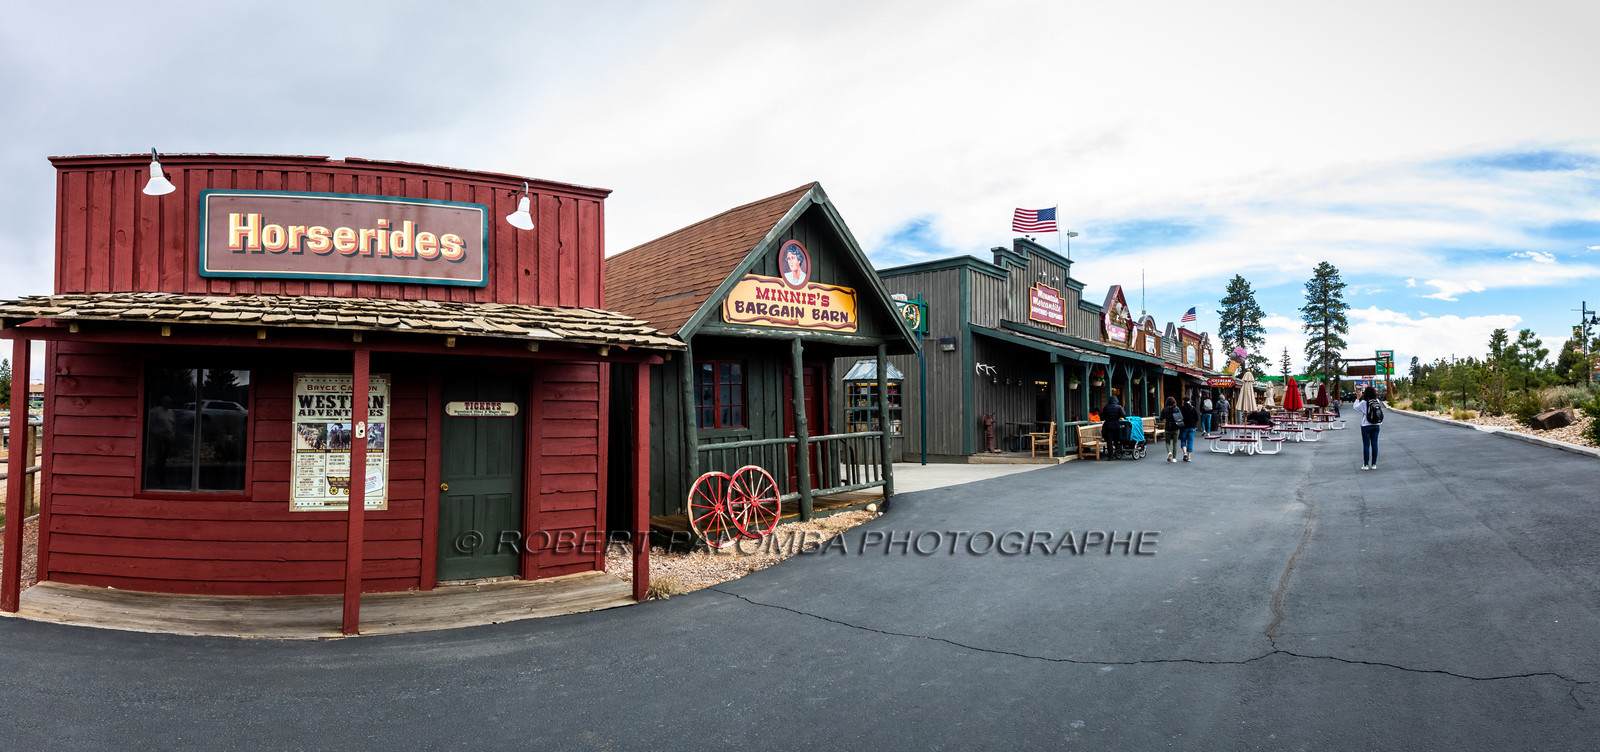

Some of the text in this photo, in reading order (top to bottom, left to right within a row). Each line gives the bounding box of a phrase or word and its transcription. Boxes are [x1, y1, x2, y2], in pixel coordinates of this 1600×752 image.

[228, 213, 466, 262] Horserides
[756, 287, 830, 307] MINNIE'S
[735, 300, 848, 323] BARGAIN BARN
[298, 395, 384, 408] WESTN
[464, 401, 501, 410] TICKETS
